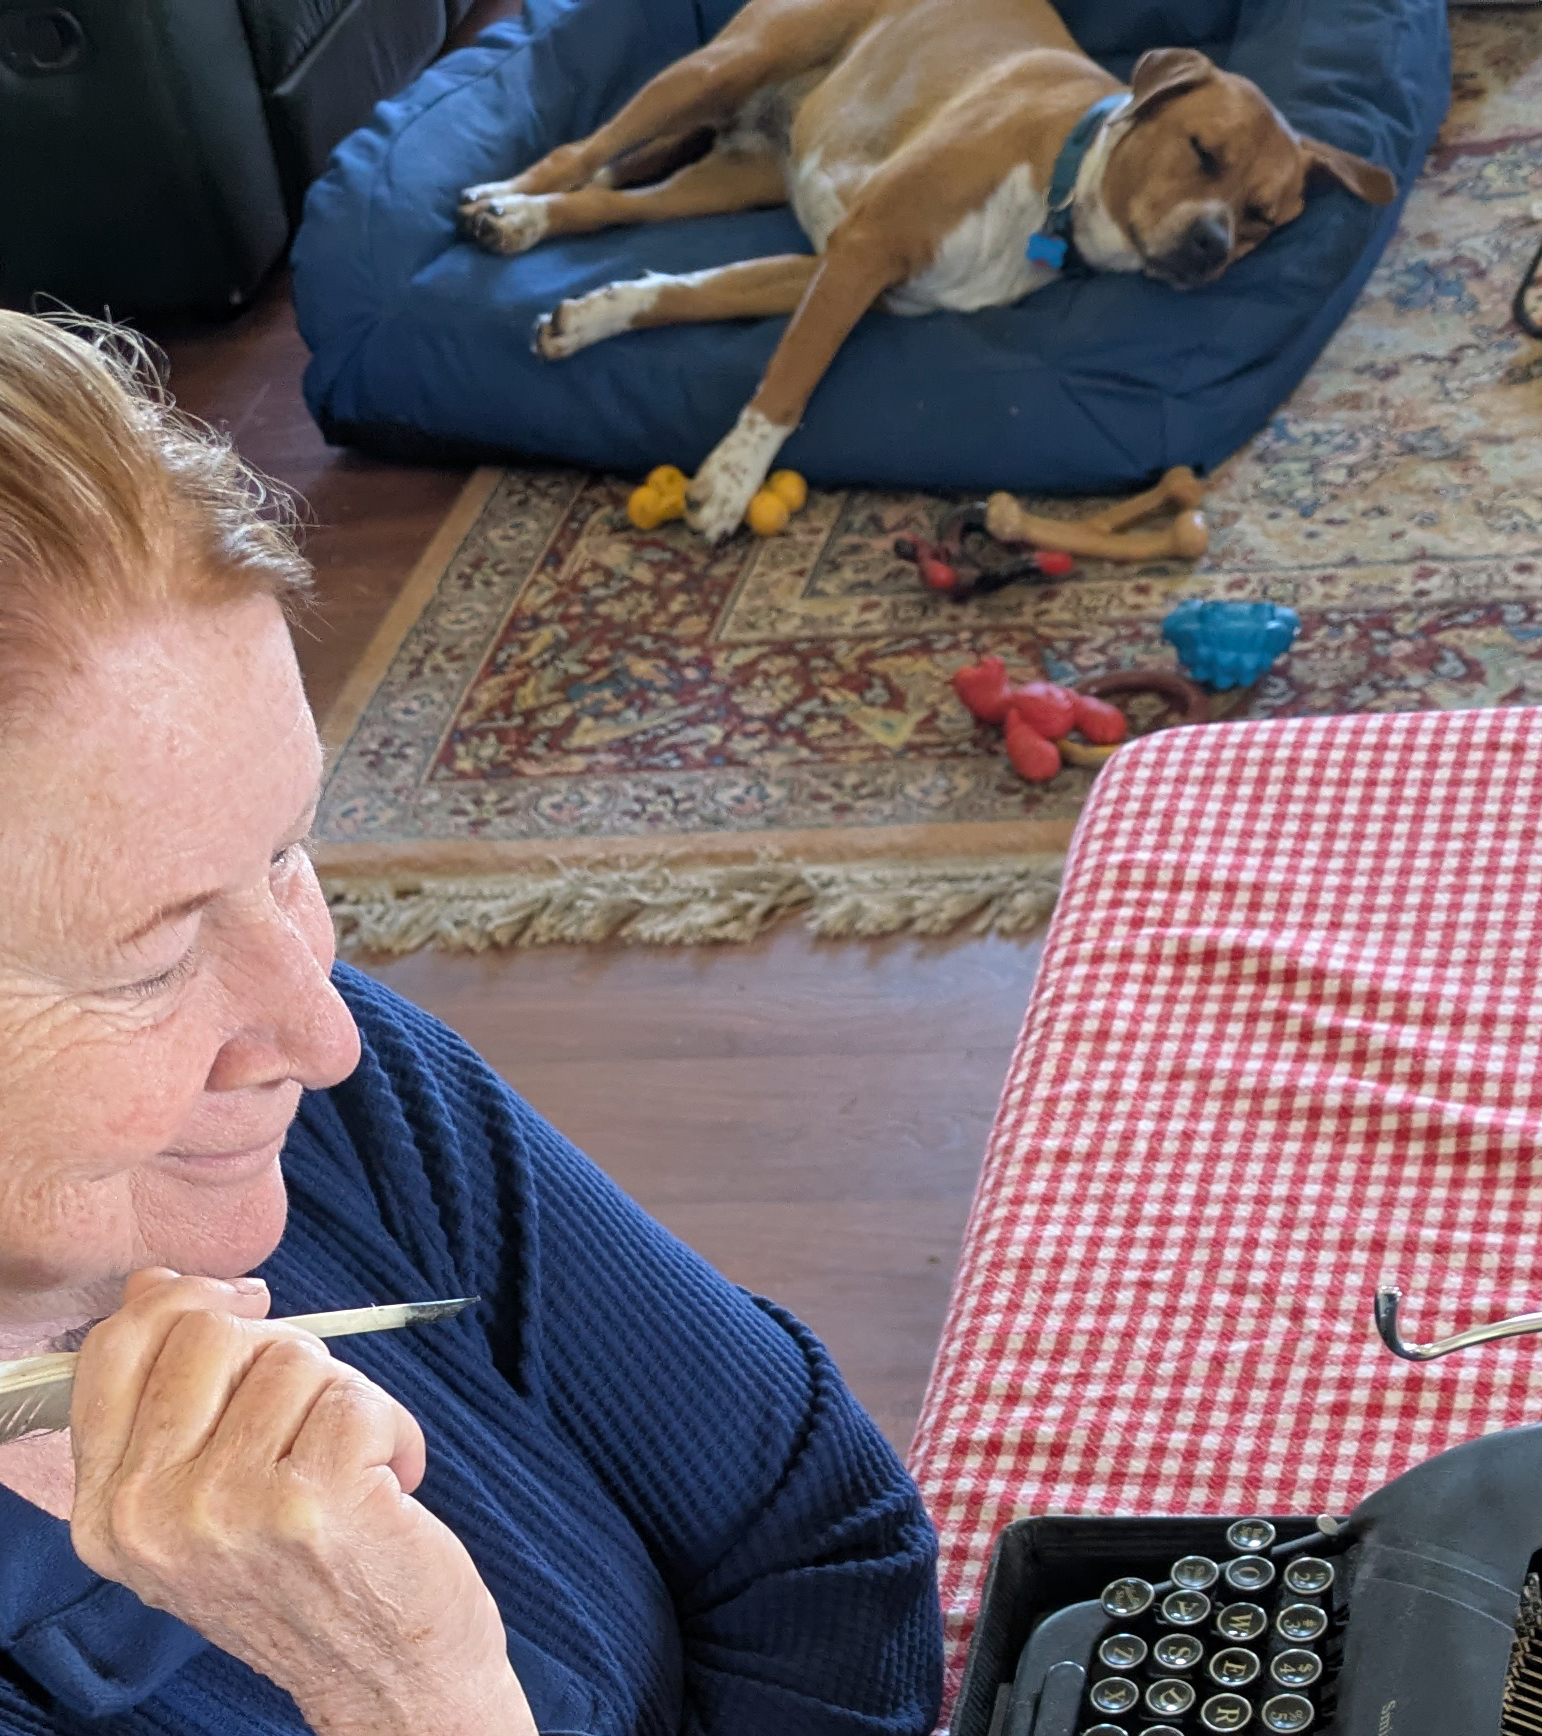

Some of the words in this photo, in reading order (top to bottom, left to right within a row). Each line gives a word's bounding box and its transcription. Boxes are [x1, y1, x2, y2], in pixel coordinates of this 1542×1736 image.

[1235, 1566, 1259, 1582] Q
[1293, 1570, 1311, 1586] 2
[1177, 1598, 1199, 1616] A
[1229, 1612, 1253, 1634] W
[1283, 1618, 1301, 1630] 3
[1113, 1646, 1135, 1662] Z
[1167, 1644, 1191, 1658] S
[1221, 1658, 1247, 1676] E
[1279, 1662, 1295, 1674] 4
[1103, 1688, 1125, 1702] X
[1159, 1686, 1183, 1704] D
[1215, 1706, 1241, 1724] R
[1271, 1710, 1289, 1720] 5
